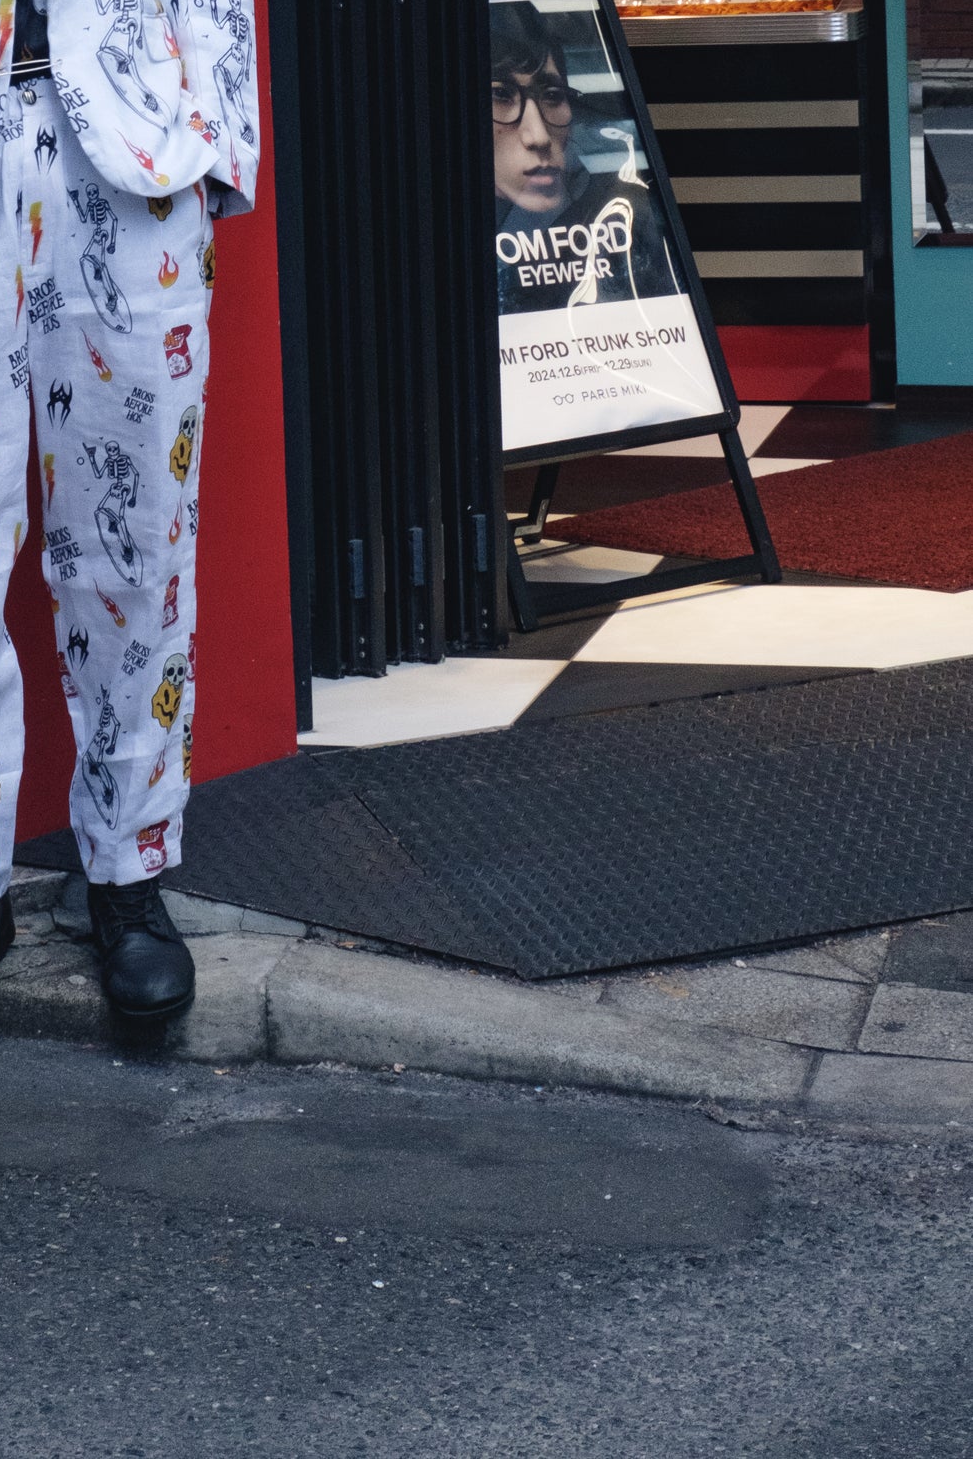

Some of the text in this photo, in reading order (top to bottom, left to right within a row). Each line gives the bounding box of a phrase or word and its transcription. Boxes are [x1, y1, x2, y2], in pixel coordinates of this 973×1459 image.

[548, 220, 631, 259] FORD
[518, 258, 614, 288] EYEWEAR
[519, 341, 570, 363] FORD
[571, 332, 635, 355] TRUNK
[635, 326, 687, 348] SHOW
[582, 387, 618, 403] PARIS
[59, 561, 78, 582] HOS
